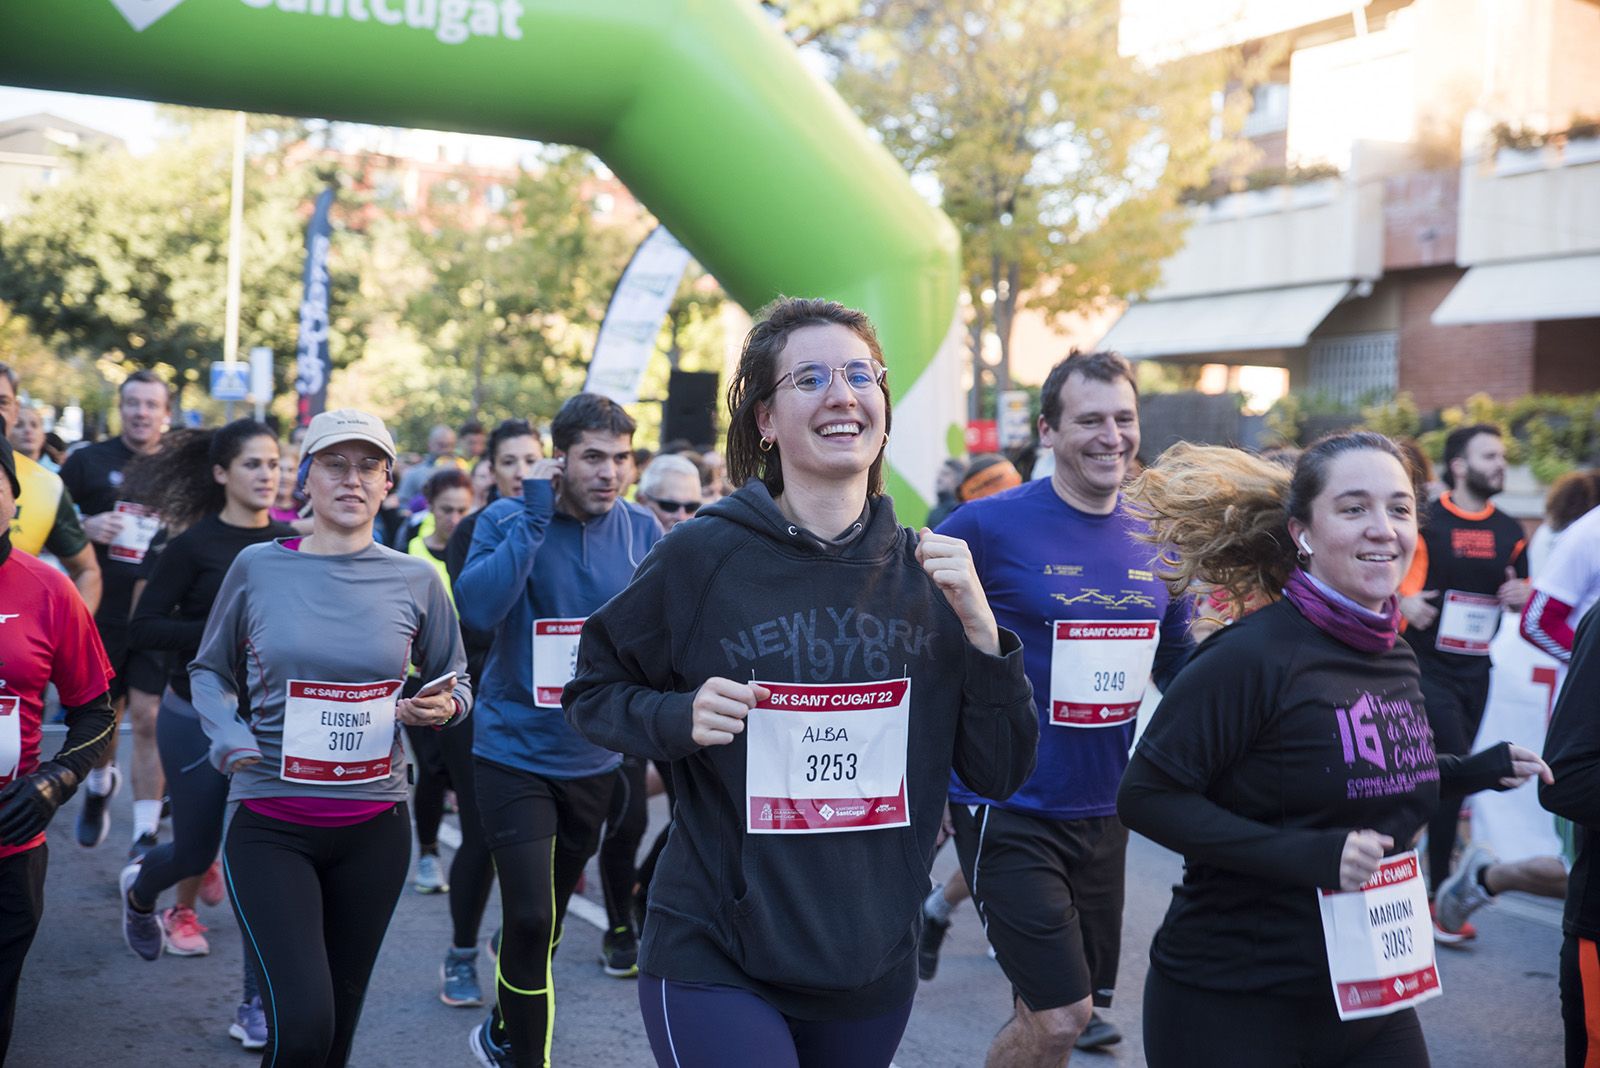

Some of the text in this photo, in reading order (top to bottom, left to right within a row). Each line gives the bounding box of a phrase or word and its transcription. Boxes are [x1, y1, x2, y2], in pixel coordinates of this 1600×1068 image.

[719, 606, 940, 669] NEW YORK
[1082, 627, 1106, 637] SANT
[1107, 627, 1139, 637] CUGAT
[1138, 627, 1149, 636] 22
[784, 632, 890, 682] 1976
[1094, 671, 1125, 692] 3249
[317, 688, 345, 699] SANT
[346, 688, 377, 699] CUGAT
[770, 691, 893, 707] 5K SANT CUGAT 22
[321, 710, 372, 728] ELISENDA
[328, 731, 364, 751] 3107
[801, 726, 849, 743] ALBA
[806, 753, 858, 782] 3253
[835, 808, 866, 817] SantCugat
[1369, 897, 1414, 928] MARIONA
[1381, 926, 1414, 960] 3093
